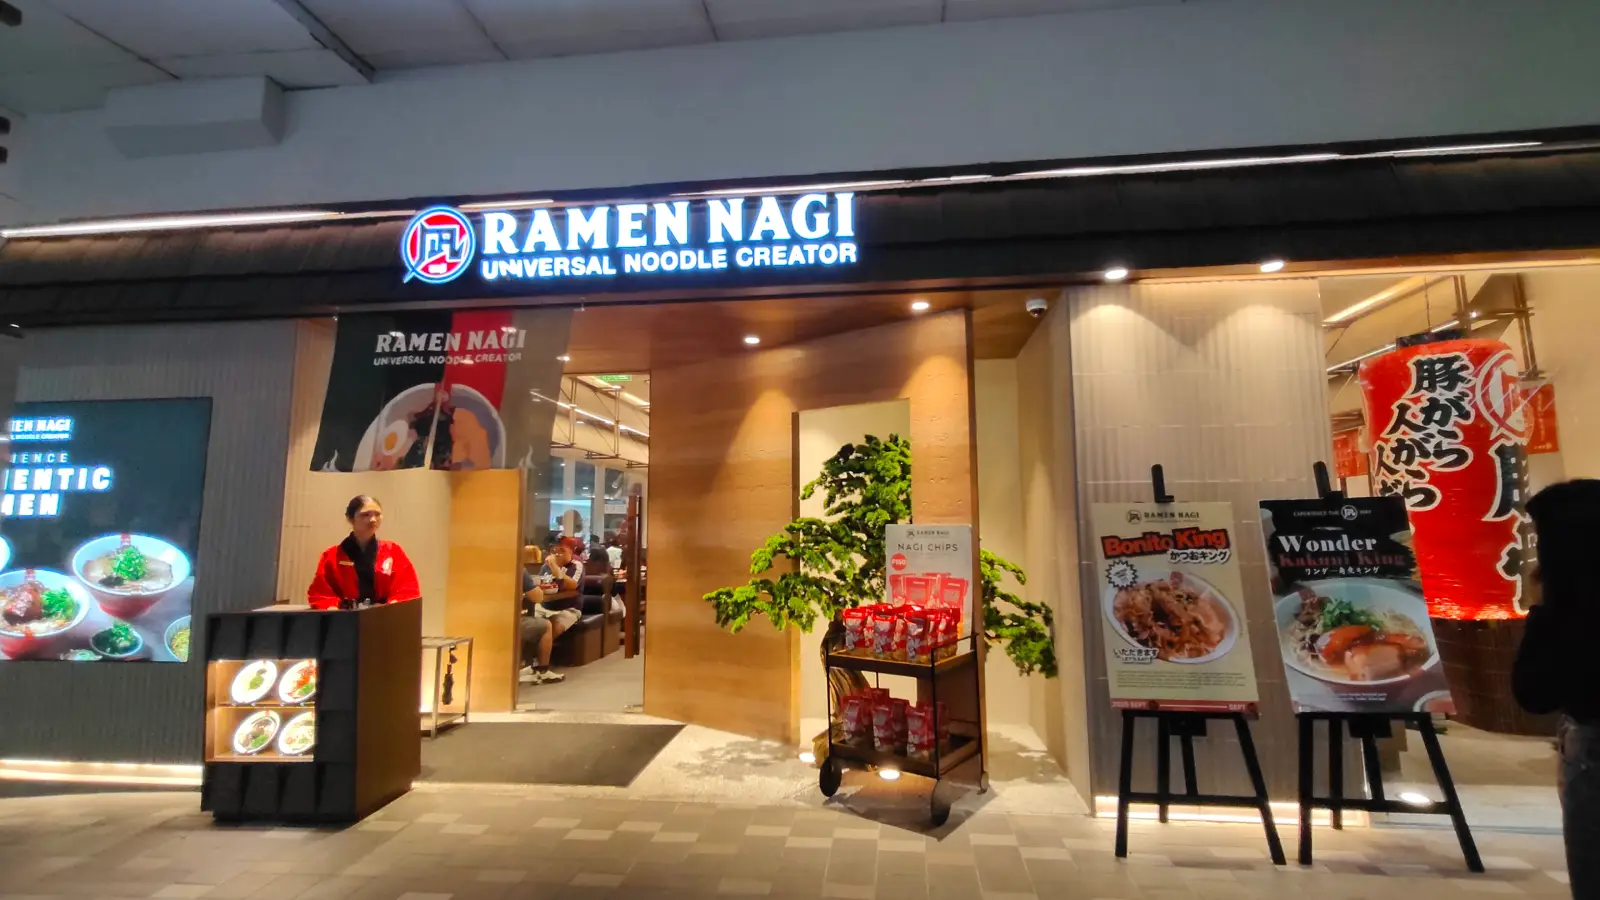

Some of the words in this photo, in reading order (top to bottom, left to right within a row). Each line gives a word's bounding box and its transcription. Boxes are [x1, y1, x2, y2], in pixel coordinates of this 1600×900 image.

[482, 200, 691, 254] RAMEN
[707, 192, 855, 243] NAGI
[481, 254, 617, 280] UNIVERSAL
[624, 249, 728, 273] NOODLE
[736, 242, 857, 268] CREATOR
[375, 332, 461, 353] RAMEN
[467, 329, 527, 350] NAGI
[373, 355, 425, 366] UNIVERSAL
[429, 354, 473, 365] NOODLE
[475, 352, 522, 363] CREATOR
[12, 420, 33, 431] EN
[37, 419, 71, 431] NAGI
[4, 467, 111, 490] ENTIC
[897, 543, 923, 551] NAGI
[1102, 533, 1172, 558] Bonito
[1174, 527, 1229, 549] King
[1278, 534, 1377, 552] Wonder
[1170, 549, 1229, 562] かつおキング
[1357, 552, 1406, 567] King
